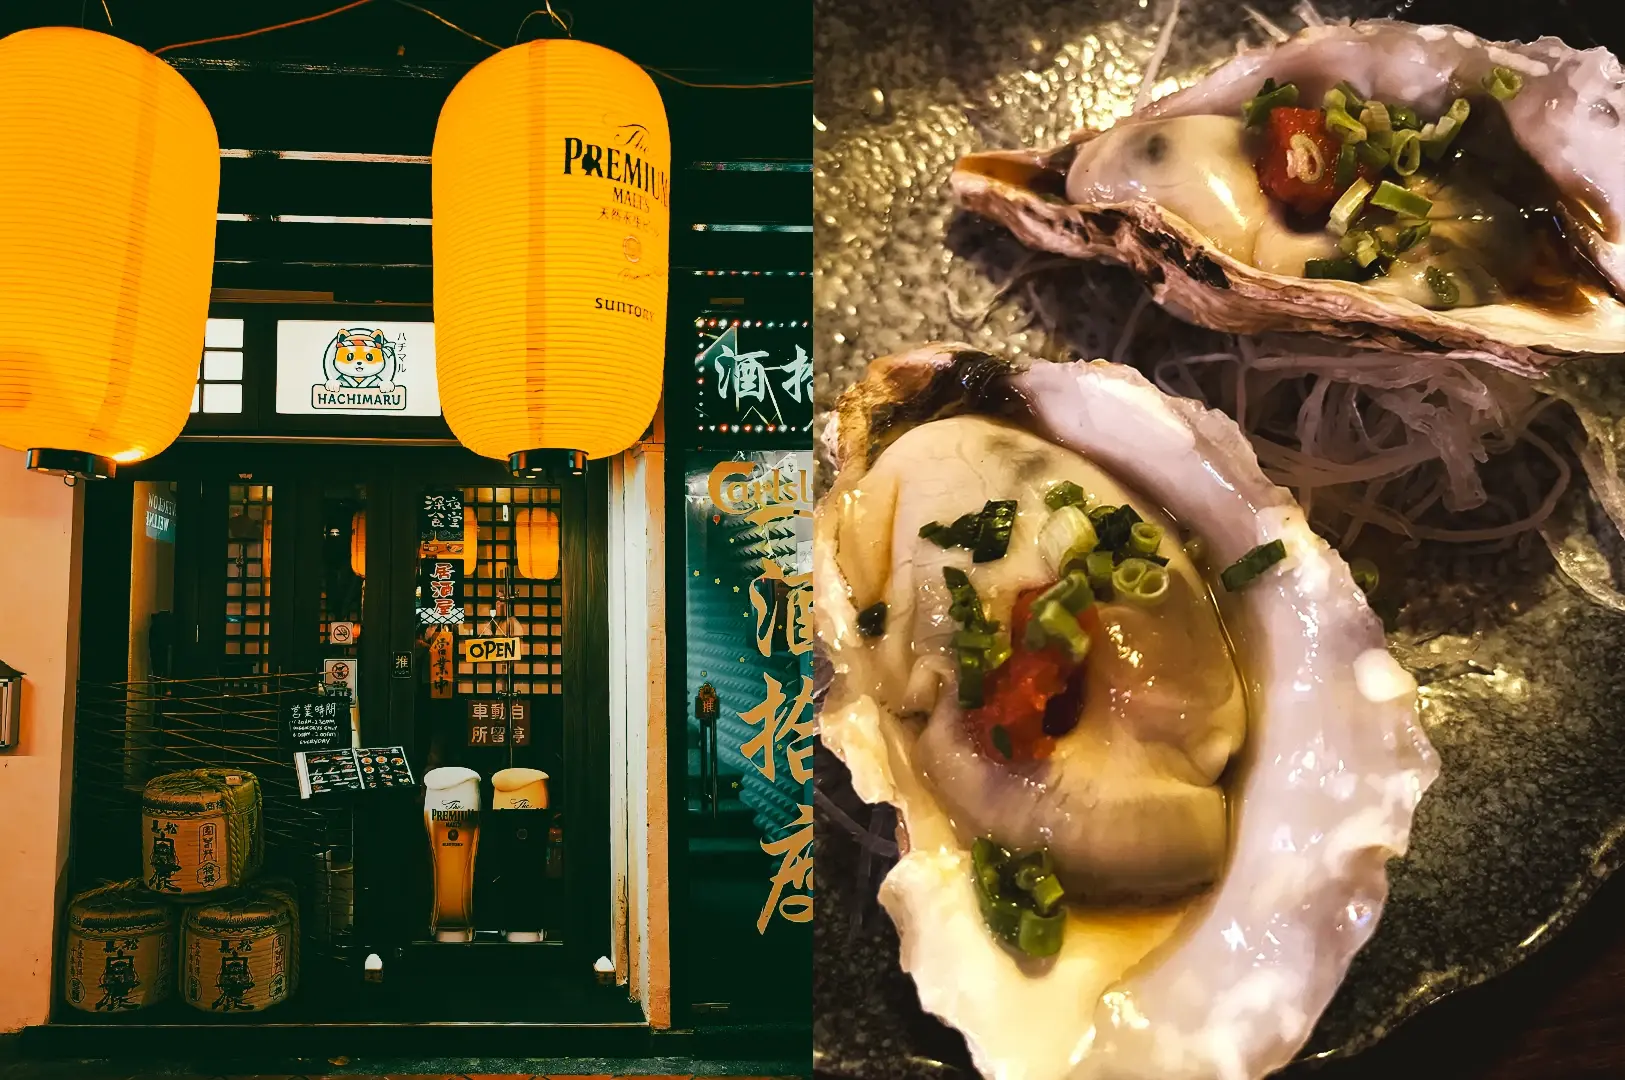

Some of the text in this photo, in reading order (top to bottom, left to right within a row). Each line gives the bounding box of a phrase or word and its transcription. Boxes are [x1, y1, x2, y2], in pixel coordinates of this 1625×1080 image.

[613, 123, 650, 155] The
[612, 186, 650, 214] MALTS
[594, 296, 655, 323] SUNTORY
[397, 332, 407, 373] ハチマル
[317, 393, 401, 405] HACHIMARU
[429, 562, 456, 617] 居酒屋
[395, 656, 409, 669] 推
[469, 641, 516, 659] OPEN
